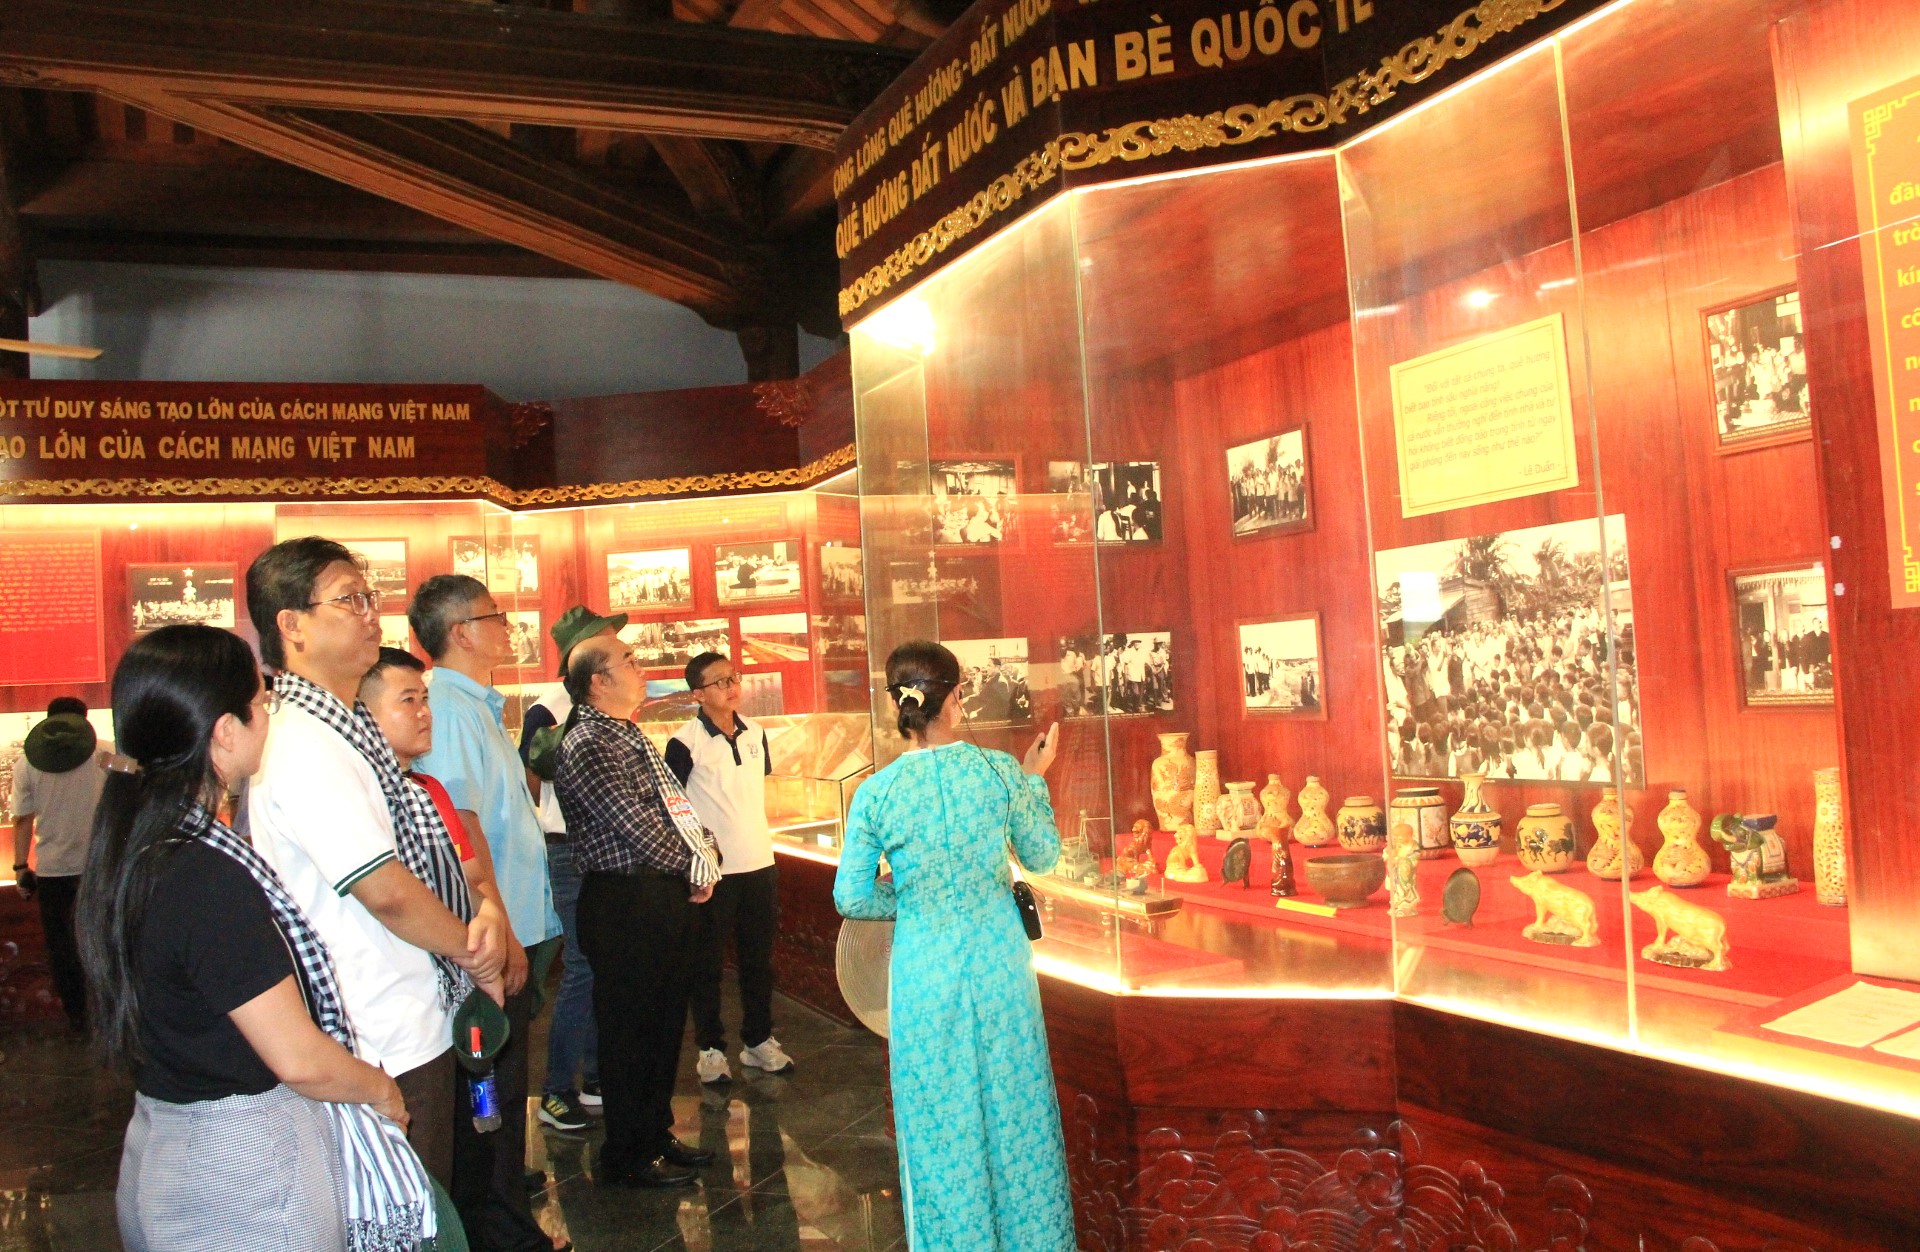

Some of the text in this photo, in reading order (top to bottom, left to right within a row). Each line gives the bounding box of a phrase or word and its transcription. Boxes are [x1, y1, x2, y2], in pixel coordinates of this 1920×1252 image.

[836, 203, 861, 259] QUÊ
[862, 170, 910, 239] HƯƠNG
[911, 132, 941, 200] ĐẤT
[947, 92, 998, 172] NƯỚC
[1001, 65, 1029, 129] VÀ
[1031, 39, 1098, 108] BẠN
[1114, 14, 1175, 81] BÈ
[856, 126, 886, 177] LÒNG
[888, 95, 915, 146] QUÊ
[23, 396, 50, 418] TƯ
[54, 400, 95, 419] DUY
[100, 397, 151, 420] SÁNG
[157, 401, 192, 422] TẠO
[197, 397, 234, 420] LỚN
[238, 396, 276, 420] CỦA
[280, 396, 328, 420] CÁCH
[332, 401, 384, 423] MẠNG
[388, 397, 427, 422] VIỆT
[432, 403, 470, 420] NAM
[40, 428, 86, 459] LỚN
[99, 428, 146, 460] CỦA
[159, 430, 219, 459] CÁCH
[232, 436, 295, 463] MẠNG
[307, 431, 356, 462] VIỆT
[369, 436, 415, 459] NAM
